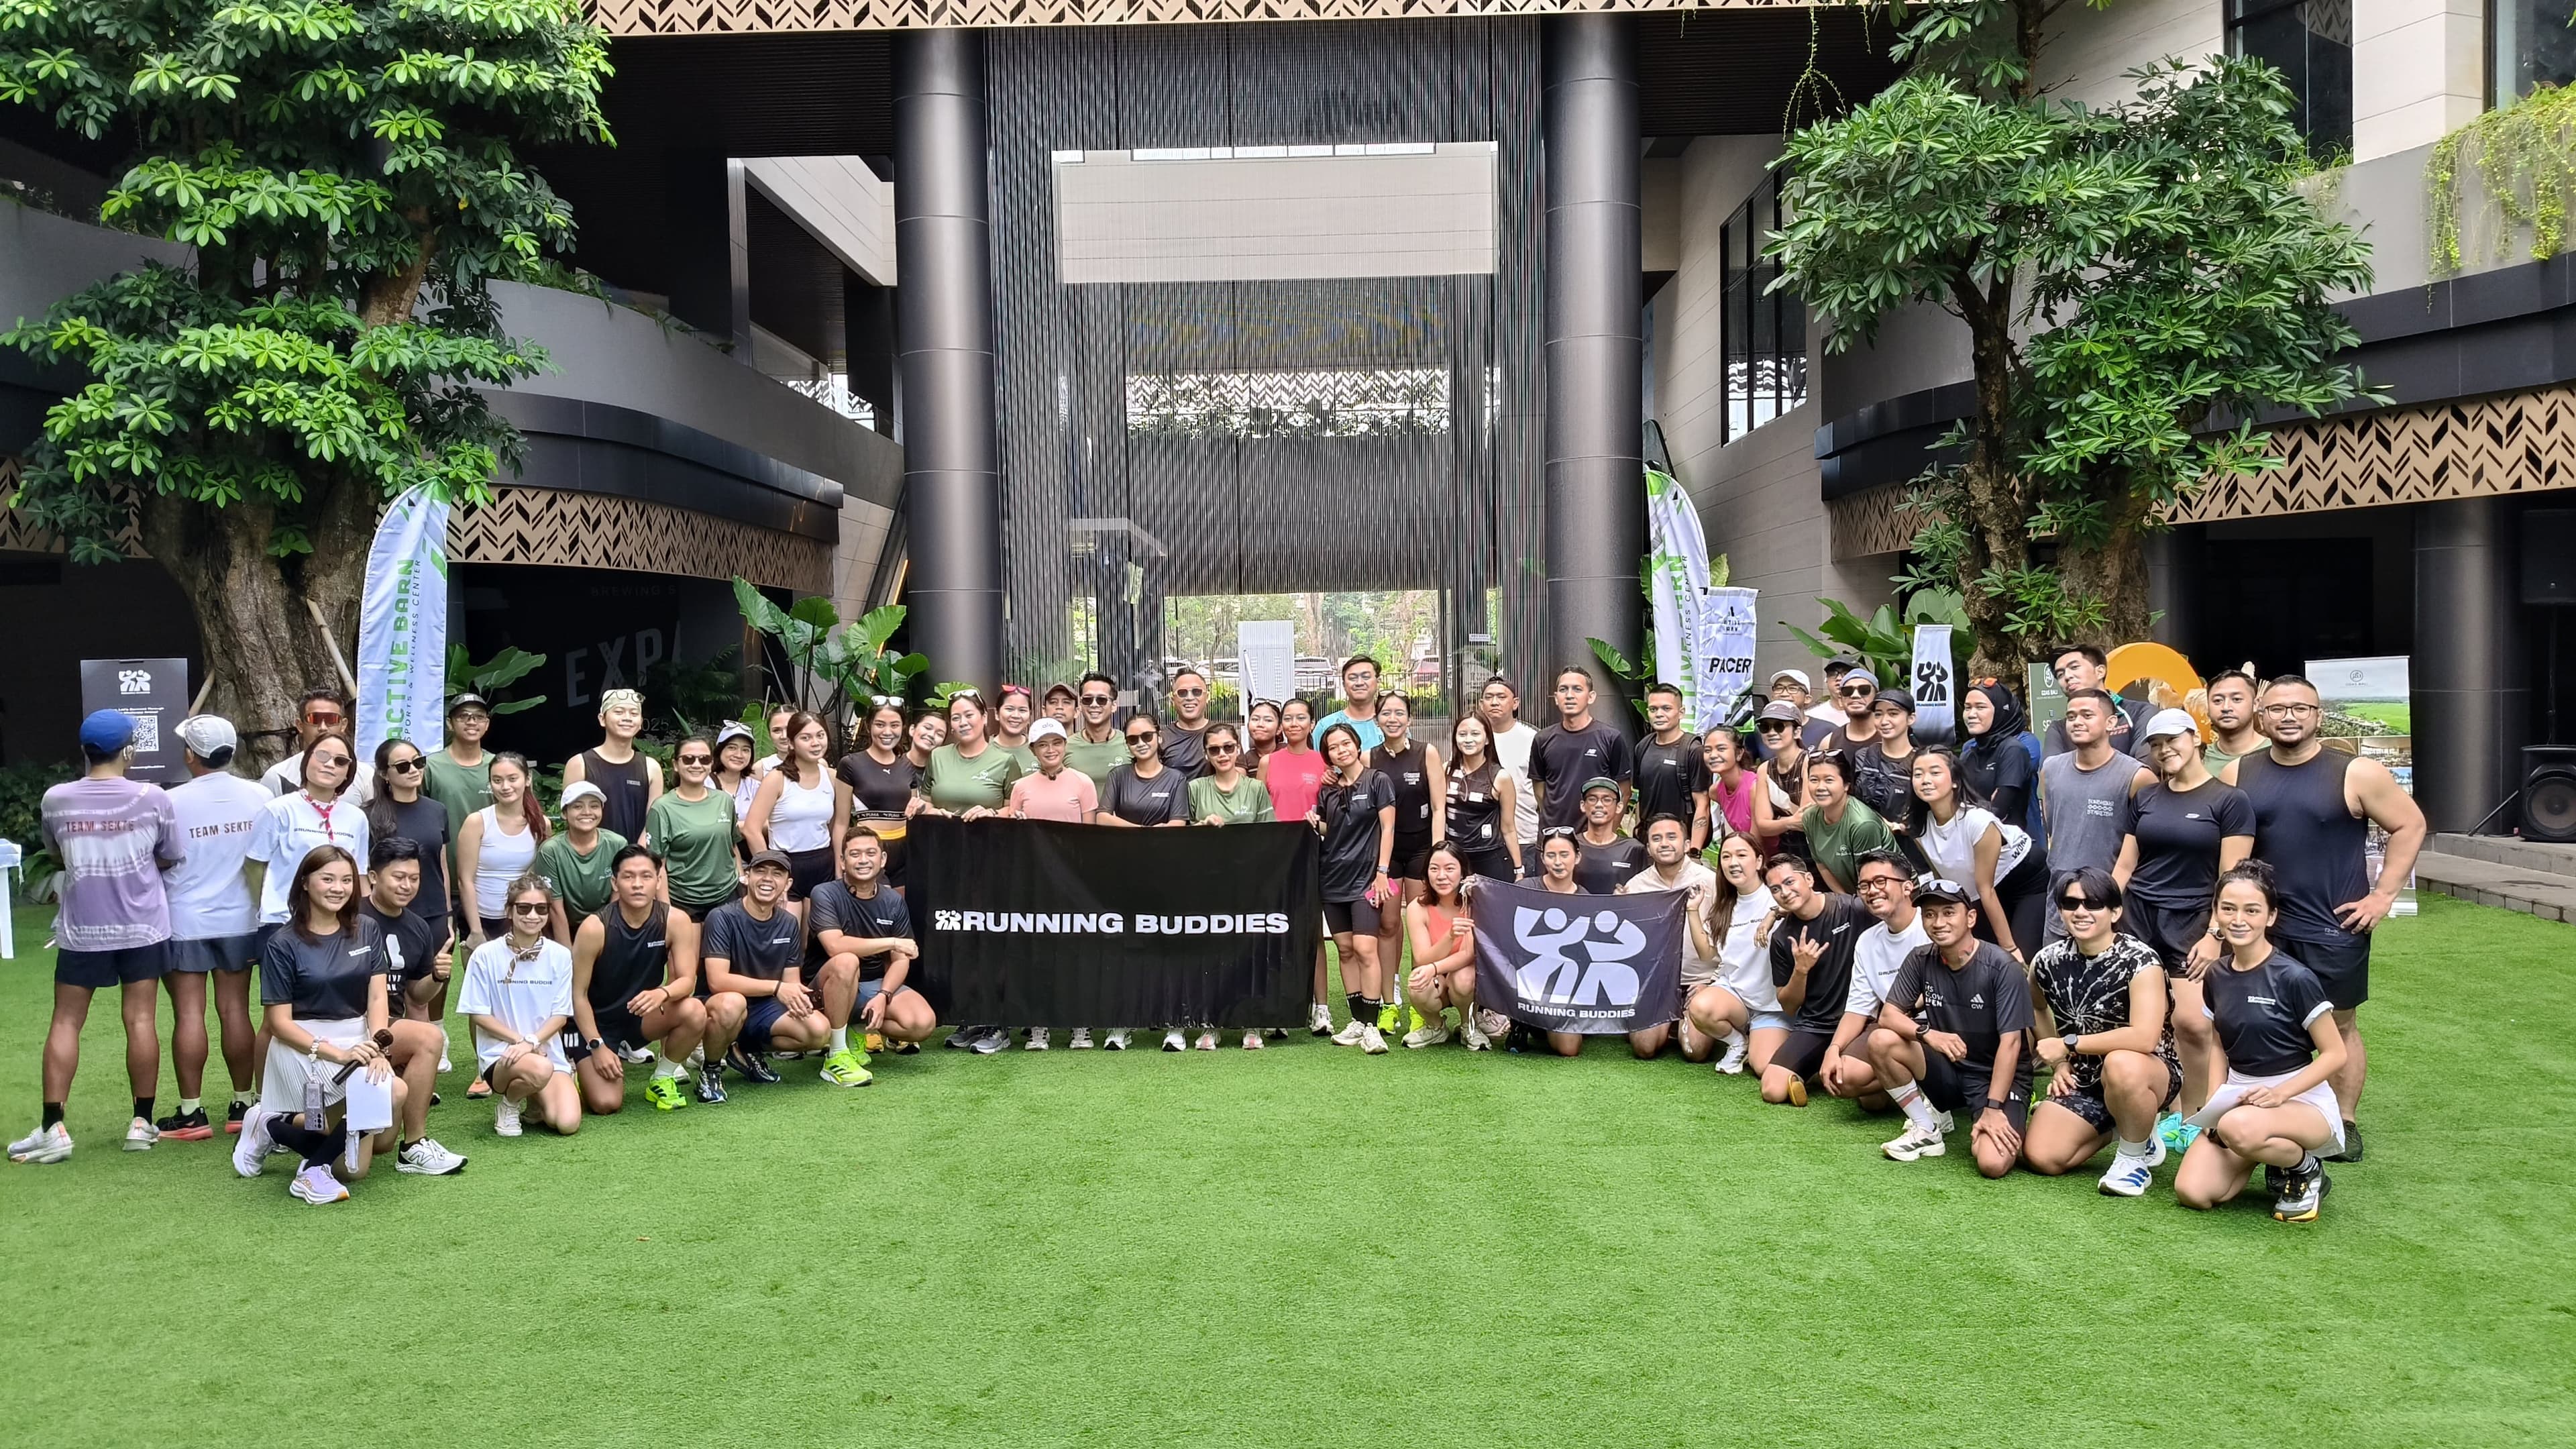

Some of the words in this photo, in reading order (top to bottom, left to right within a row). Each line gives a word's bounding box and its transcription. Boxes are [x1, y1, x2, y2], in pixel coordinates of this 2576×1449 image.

[412, 559, 421, 606] CENTER
[394, 559, 414, 631] BARN
[1709, 657, 1753, 674] PACER
[386, 640, 409, 741] ACTIVE
[189, 824, 219, 839] TEAM
[963, 911, 1124, 934] RUNNING
[1135, 913, 1289, 934] BUDDIES
[1517, 1002, 1576, 1018] RUNNING
[1578, 1008, 1636, 1018] BUDDIES
